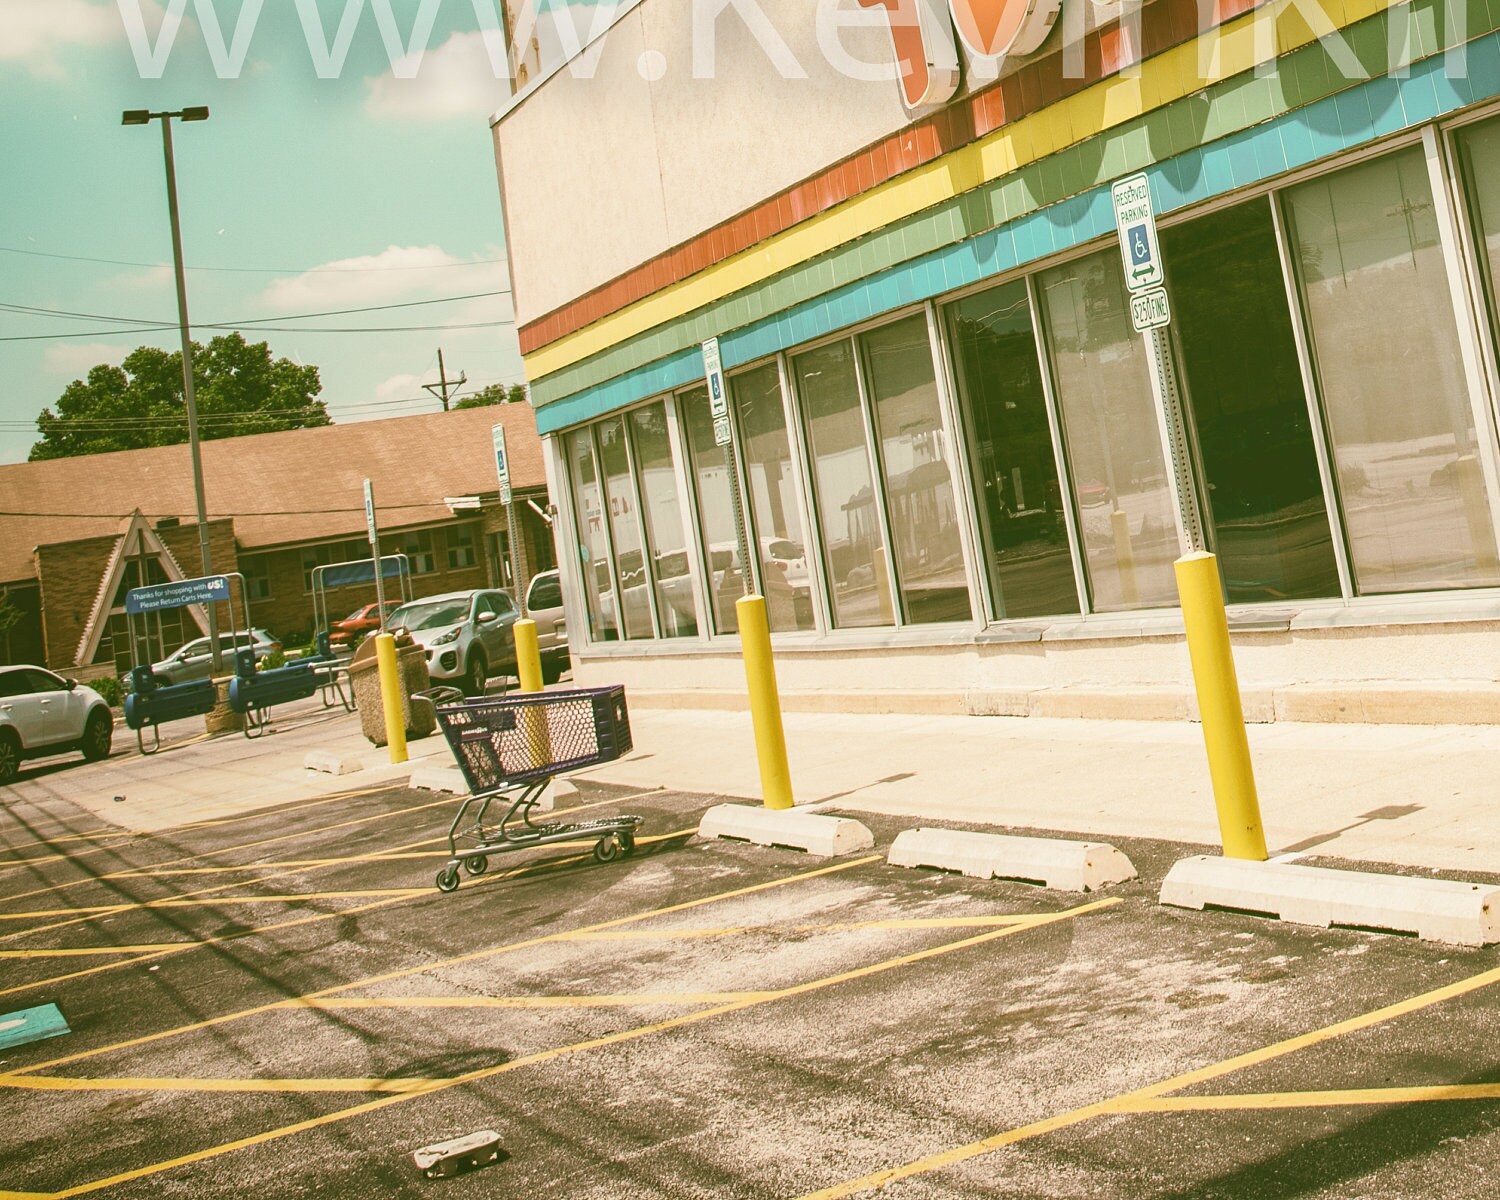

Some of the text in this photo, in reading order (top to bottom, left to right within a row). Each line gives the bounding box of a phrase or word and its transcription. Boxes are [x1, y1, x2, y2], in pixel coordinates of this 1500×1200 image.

[1115, 184, 1147, 207] RESERVED
[1121, 204, 1148, 225] PARKING
[133, 591, 153, 600] Thanks
[164, 585, 192, 596] shopping
[194, 583, 206, 592] with
[208, 579, 224, 590] US!
[140, 600, 159, 608] Please
